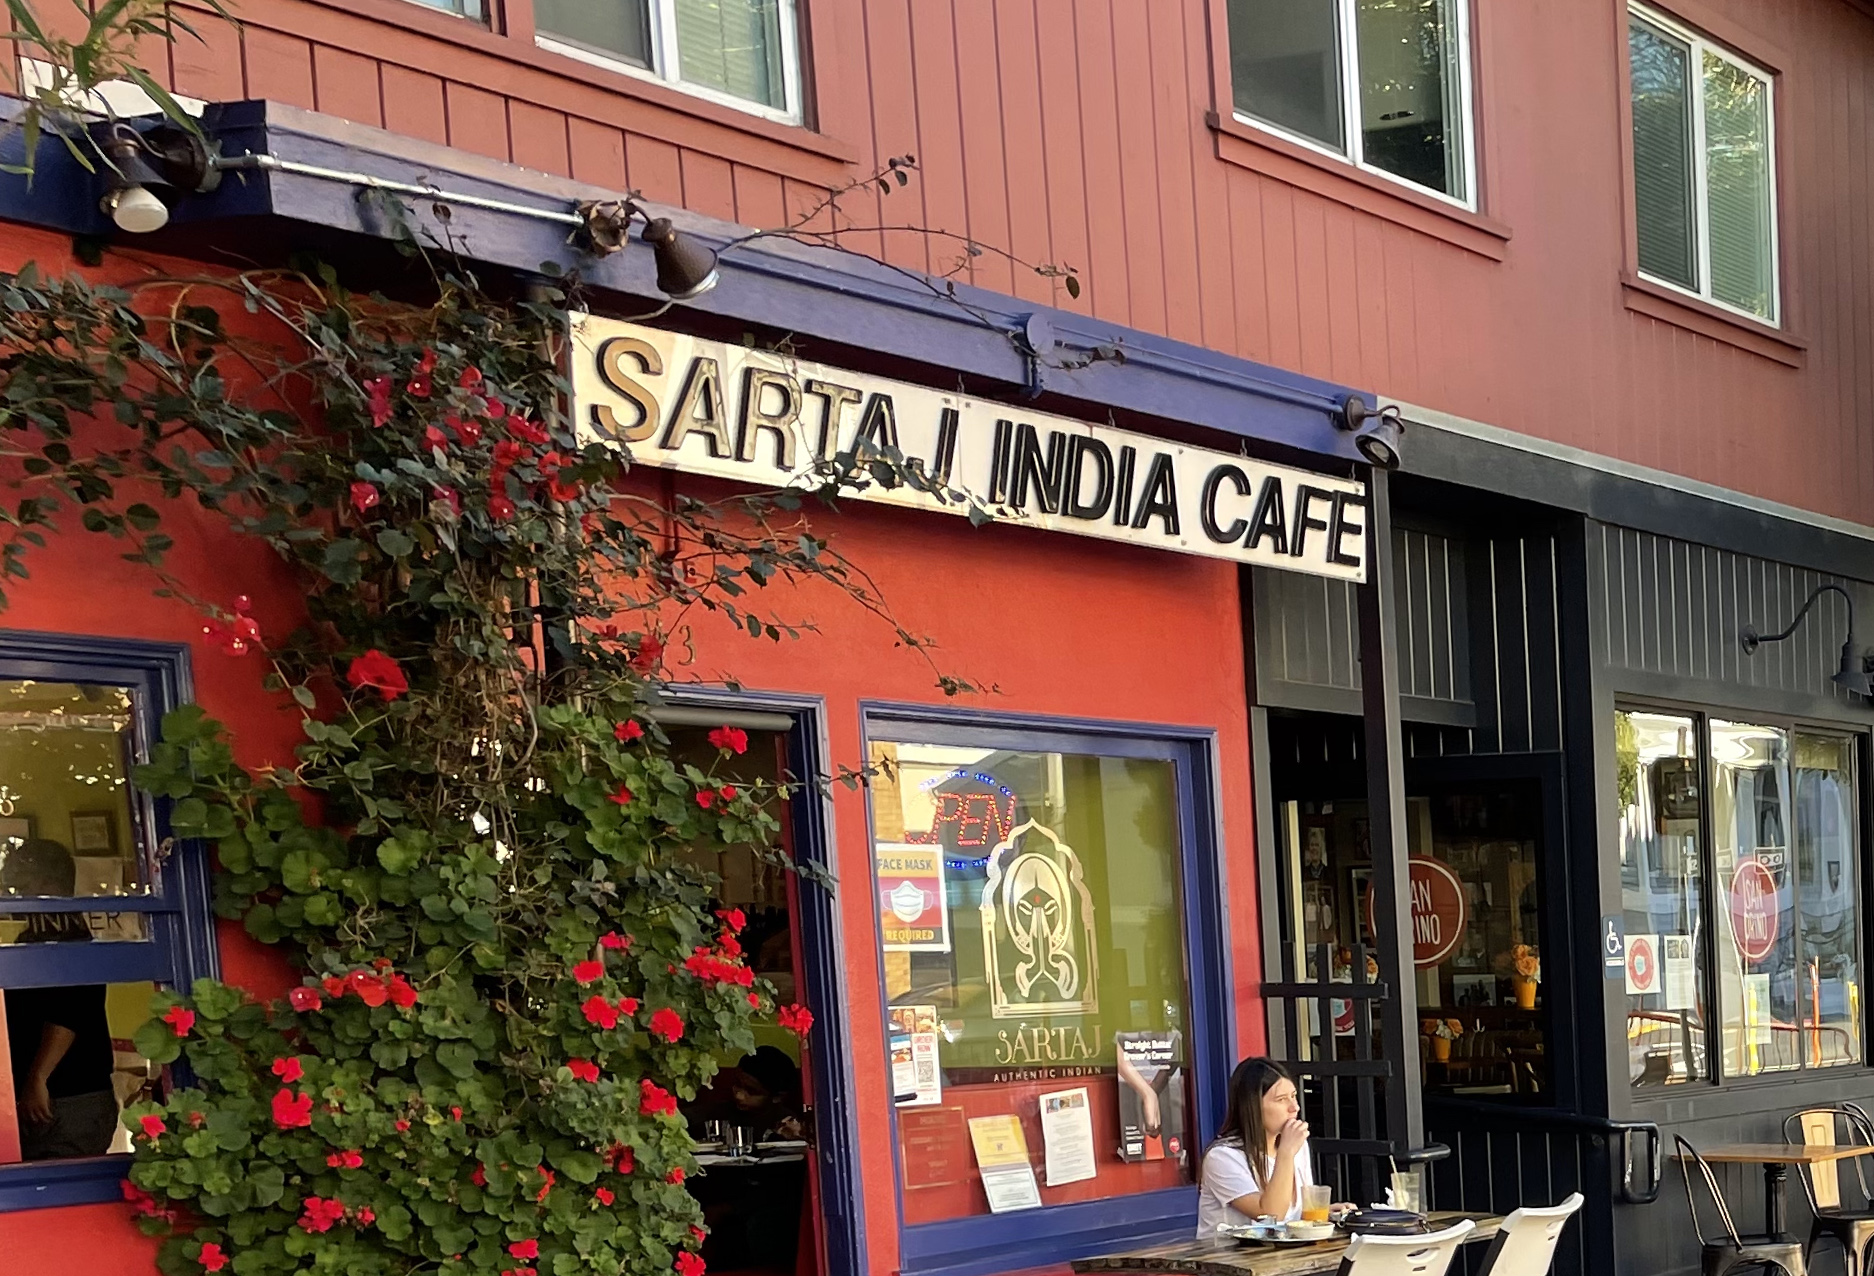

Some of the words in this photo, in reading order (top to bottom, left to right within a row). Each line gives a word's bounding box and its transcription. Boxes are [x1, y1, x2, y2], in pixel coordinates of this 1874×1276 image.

[591, 337, 959, 489] SARTAJ
[989, 419, 1180, 535] INDIA
[1201, 464, 1366, 567] CAFE
[904, 859, 933, 870] MASK
[1411, 879, 1432, 912] AN
[885, 929, 935, 942] REQUIRED
[1414, 914, 1440, 945] INO
[995, 1025, 1102, 1064] SARTAJ
[993, 1069, 1056, 1083] AUTHENTIC
[1062, 1066, 1101, 1077] INDIAN
